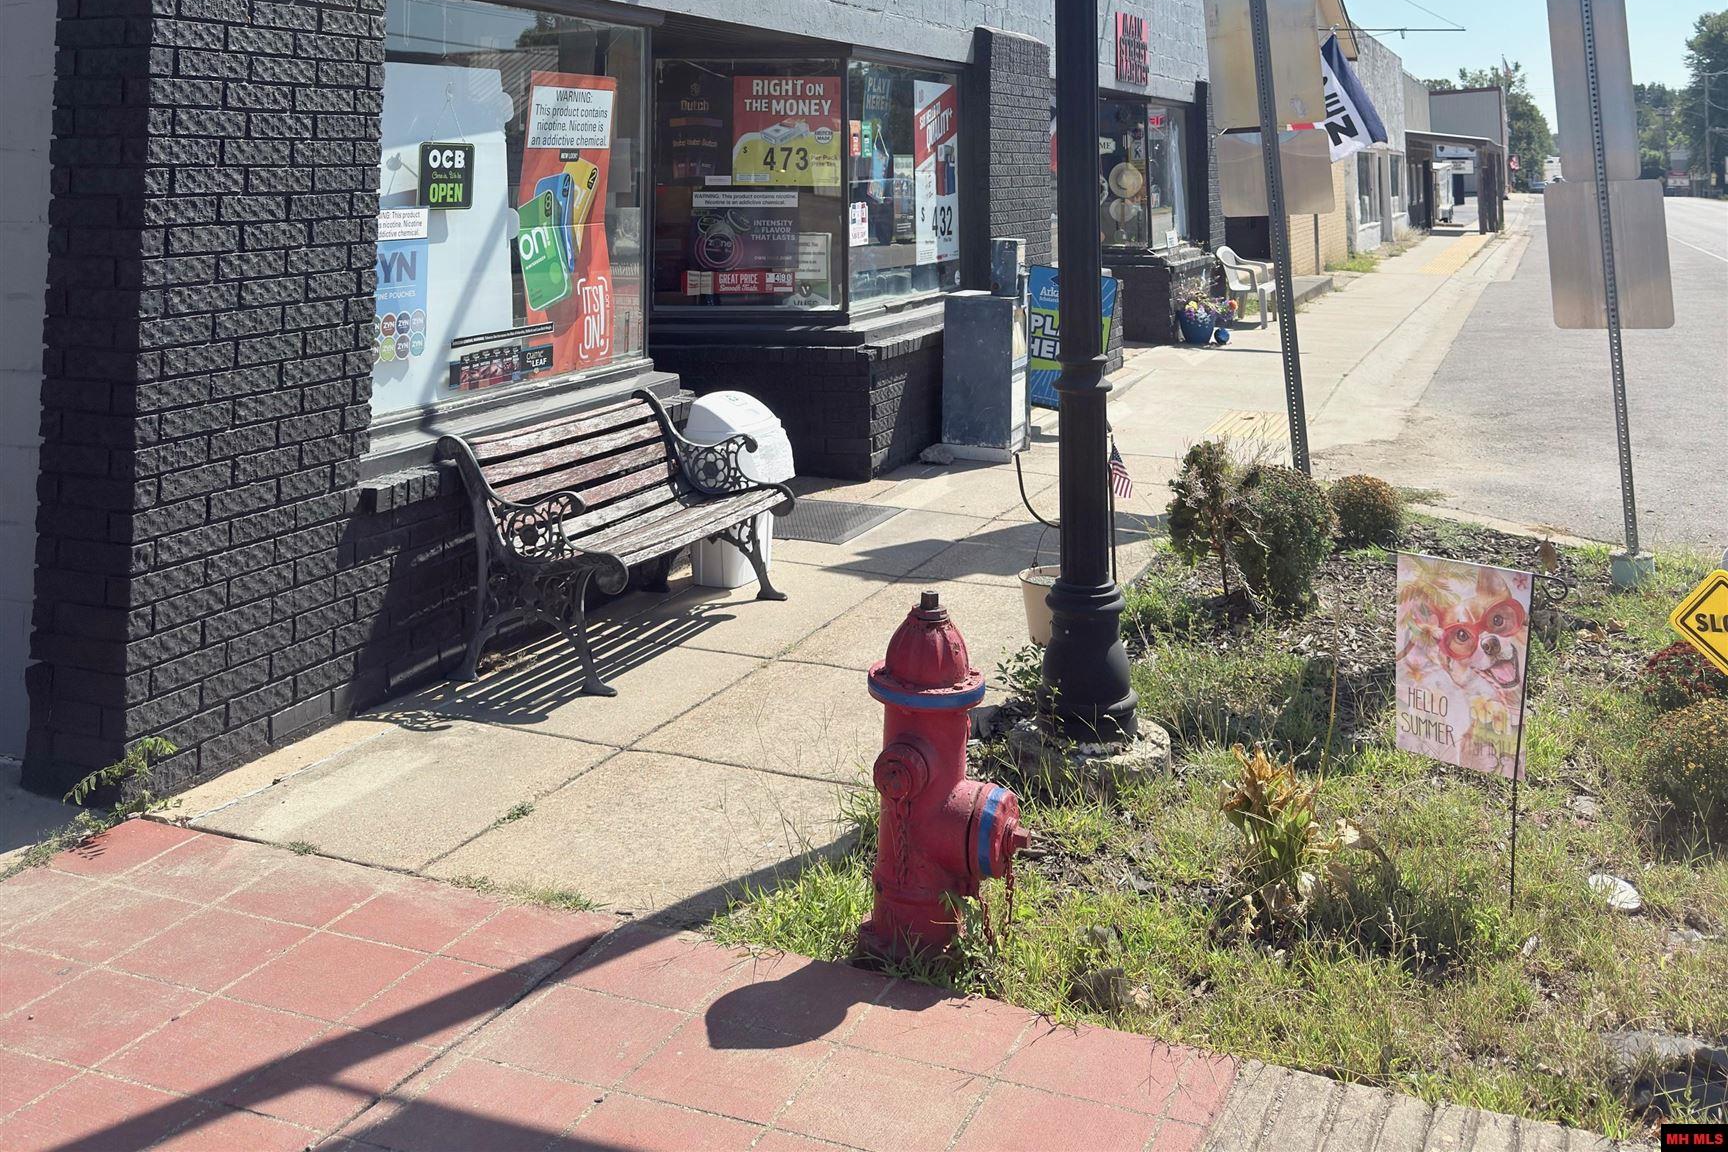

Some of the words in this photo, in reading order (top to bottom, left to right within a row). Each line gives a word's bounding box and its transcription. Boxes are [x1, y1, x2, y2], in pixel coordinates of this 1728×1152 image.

[1122, 13, 1143, 40] MAIN
[1119, 36, 1148, 65] STREET
[752, 79, 804, 96] RIGHT
[806, 83, 824, 96] ON
[556, 90, 593, 104] WARNING:
[535, 104, 550, 116] This
[552, 106, 579, 118] product
[580, 107, 608, 118] contains
[744, 99, 769, 112] THE
[771, 99, 832, 116] MONEY
[537, 119, 567, 131] nicotine.
[569, 120, 597, 132] Nicotine
[598, 121, 604, 132] is
[531, 136, 540, 146] an
[542, 134, 575, 146] addictive
[576, 135, 606, 146] chemical.
[429, 149, 466, 168] OCB
[742, 146, 748, 154] $
[429, 183, 464, 203] OPEN
[753, 219, 793, 227] INTENSITY
[520, 222, 551, 261] on!
[719, 273, 739, 283] GREAT
[740, 273, 759, 283] PRICE
[389, 291, 416, 299] POUCHES
[383, 321, 395, 329] ZYN
[1031, 314, 1059, 336] PL
[1031, 339, 1060, 360] HE
[1408, 687, 1448, 717] HELLO
[1401, 712, 1456, 747] SUMMER
